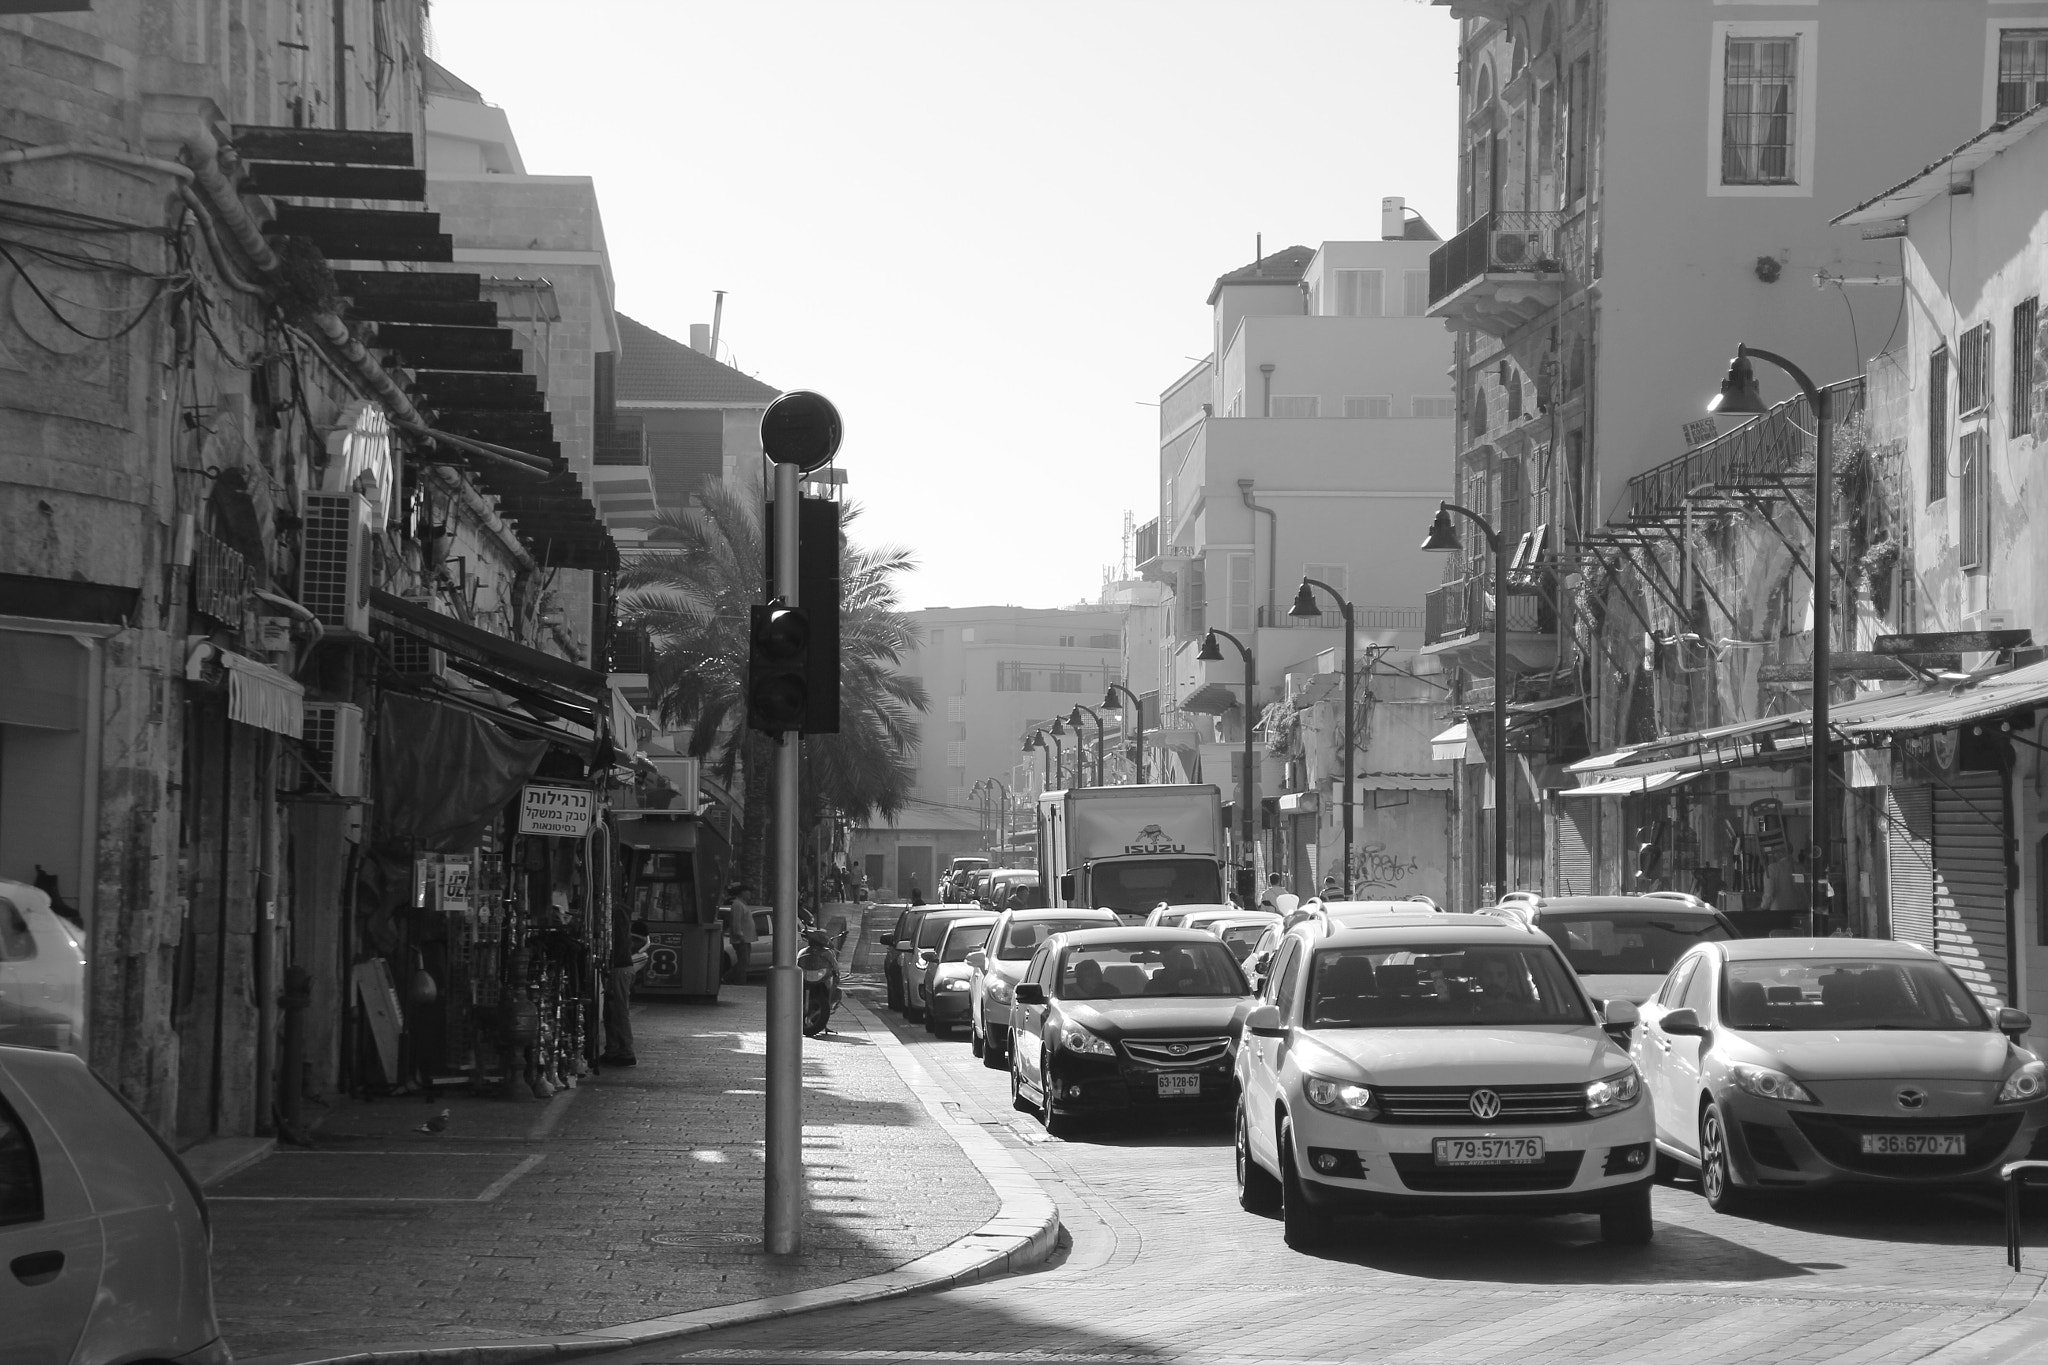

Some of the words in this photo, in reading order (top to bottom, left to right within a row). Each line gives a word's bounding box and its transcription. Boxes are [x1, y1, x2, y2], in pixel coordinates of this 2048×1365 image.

[528, 790, 587, 808] נרגילות
[526, 805, 563, 820] במשקל
[566, 811, 587, 822] טבק
[532, 822, 577, 832] בסיטונאות
[1124, 844, 1186, 854] ISUZU
